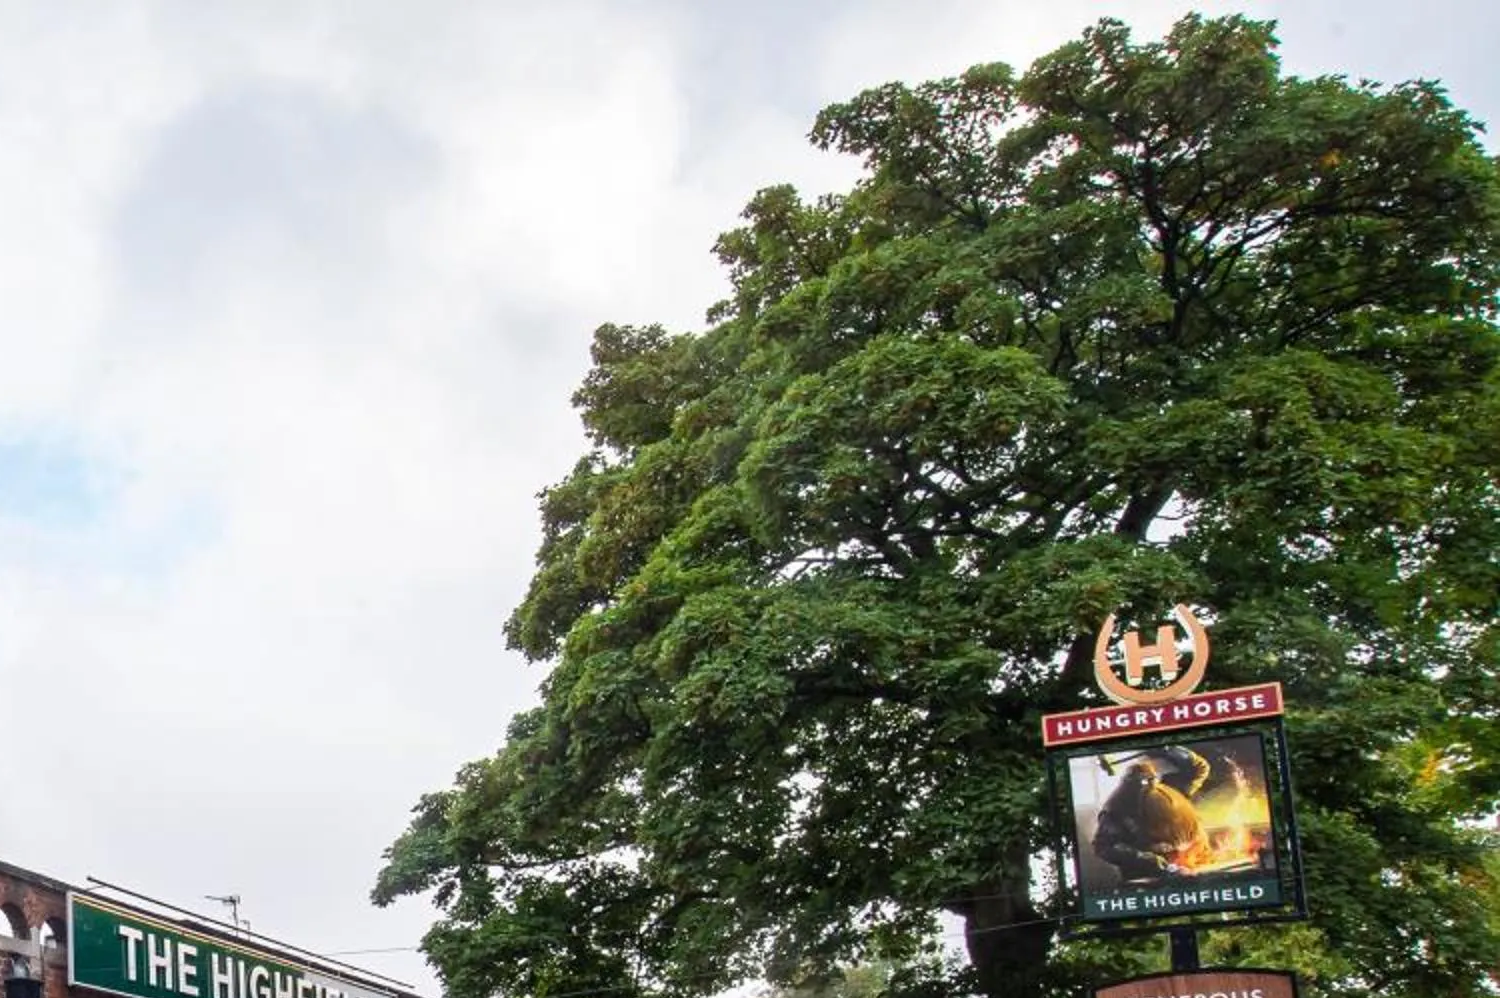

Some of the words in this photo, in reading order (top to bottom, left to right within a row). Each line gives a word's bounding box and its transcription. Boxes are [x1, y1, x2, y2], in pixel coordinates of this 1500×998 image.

[1056, 709, 1166, 737] HUNGRY
[1173, 693, 1268, 720] HORSE
[1096, 896, 1138, 913] THE
[1144, 884, 1265, 909] HIGHFIELD
[117, 924, 200, 997] THE
